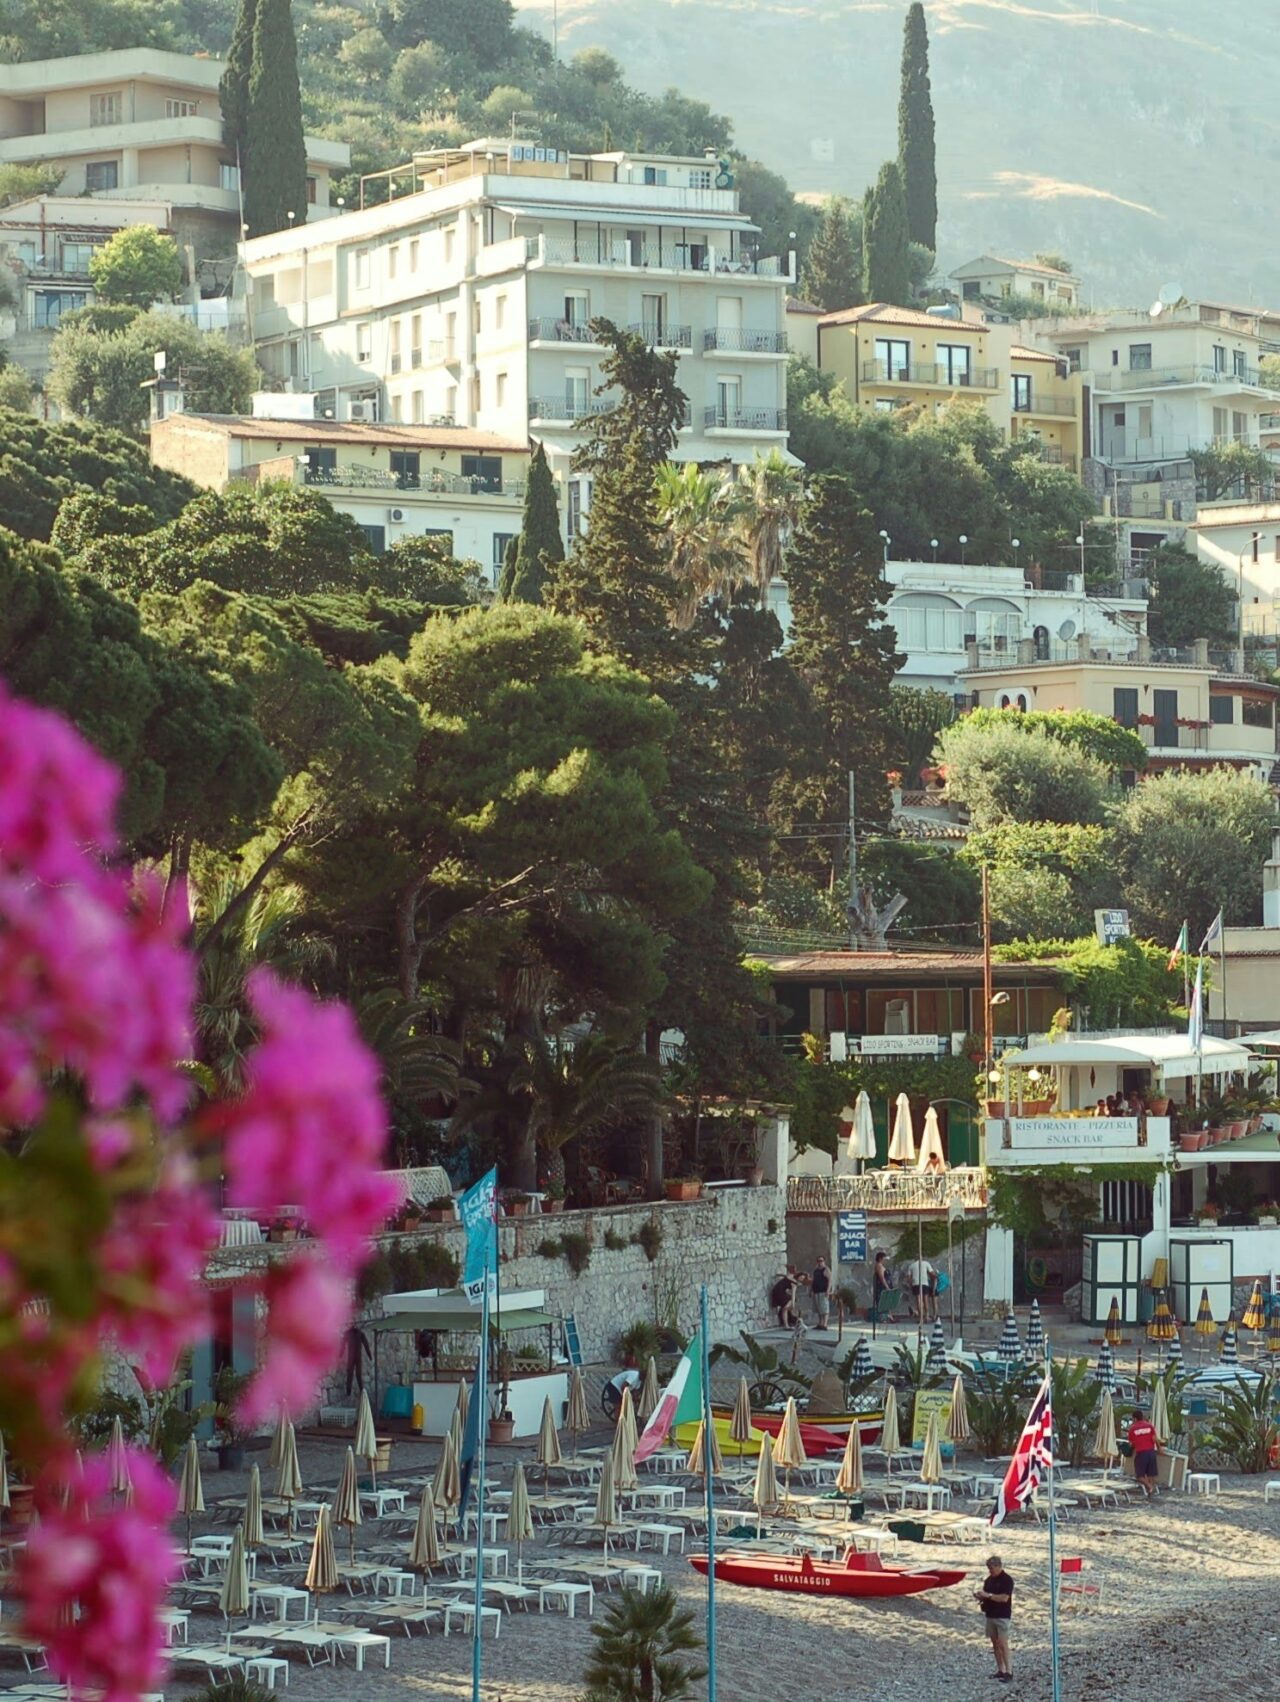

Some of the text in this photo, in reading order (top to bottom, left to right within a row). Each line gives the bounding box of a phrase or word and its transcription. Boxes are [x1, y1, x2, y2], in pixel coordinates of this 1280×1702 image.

[1016, 1121, 1078, 1131] RISTORANTE
[1089, 1120, 1133, 1130] PIZZERIA
[1046, 1134, 1104, 1144] SNACK BAR
[840, 1232, 866, 1240] SNACK
[774, 1574, 831, 1586] SALVATAGGIO
